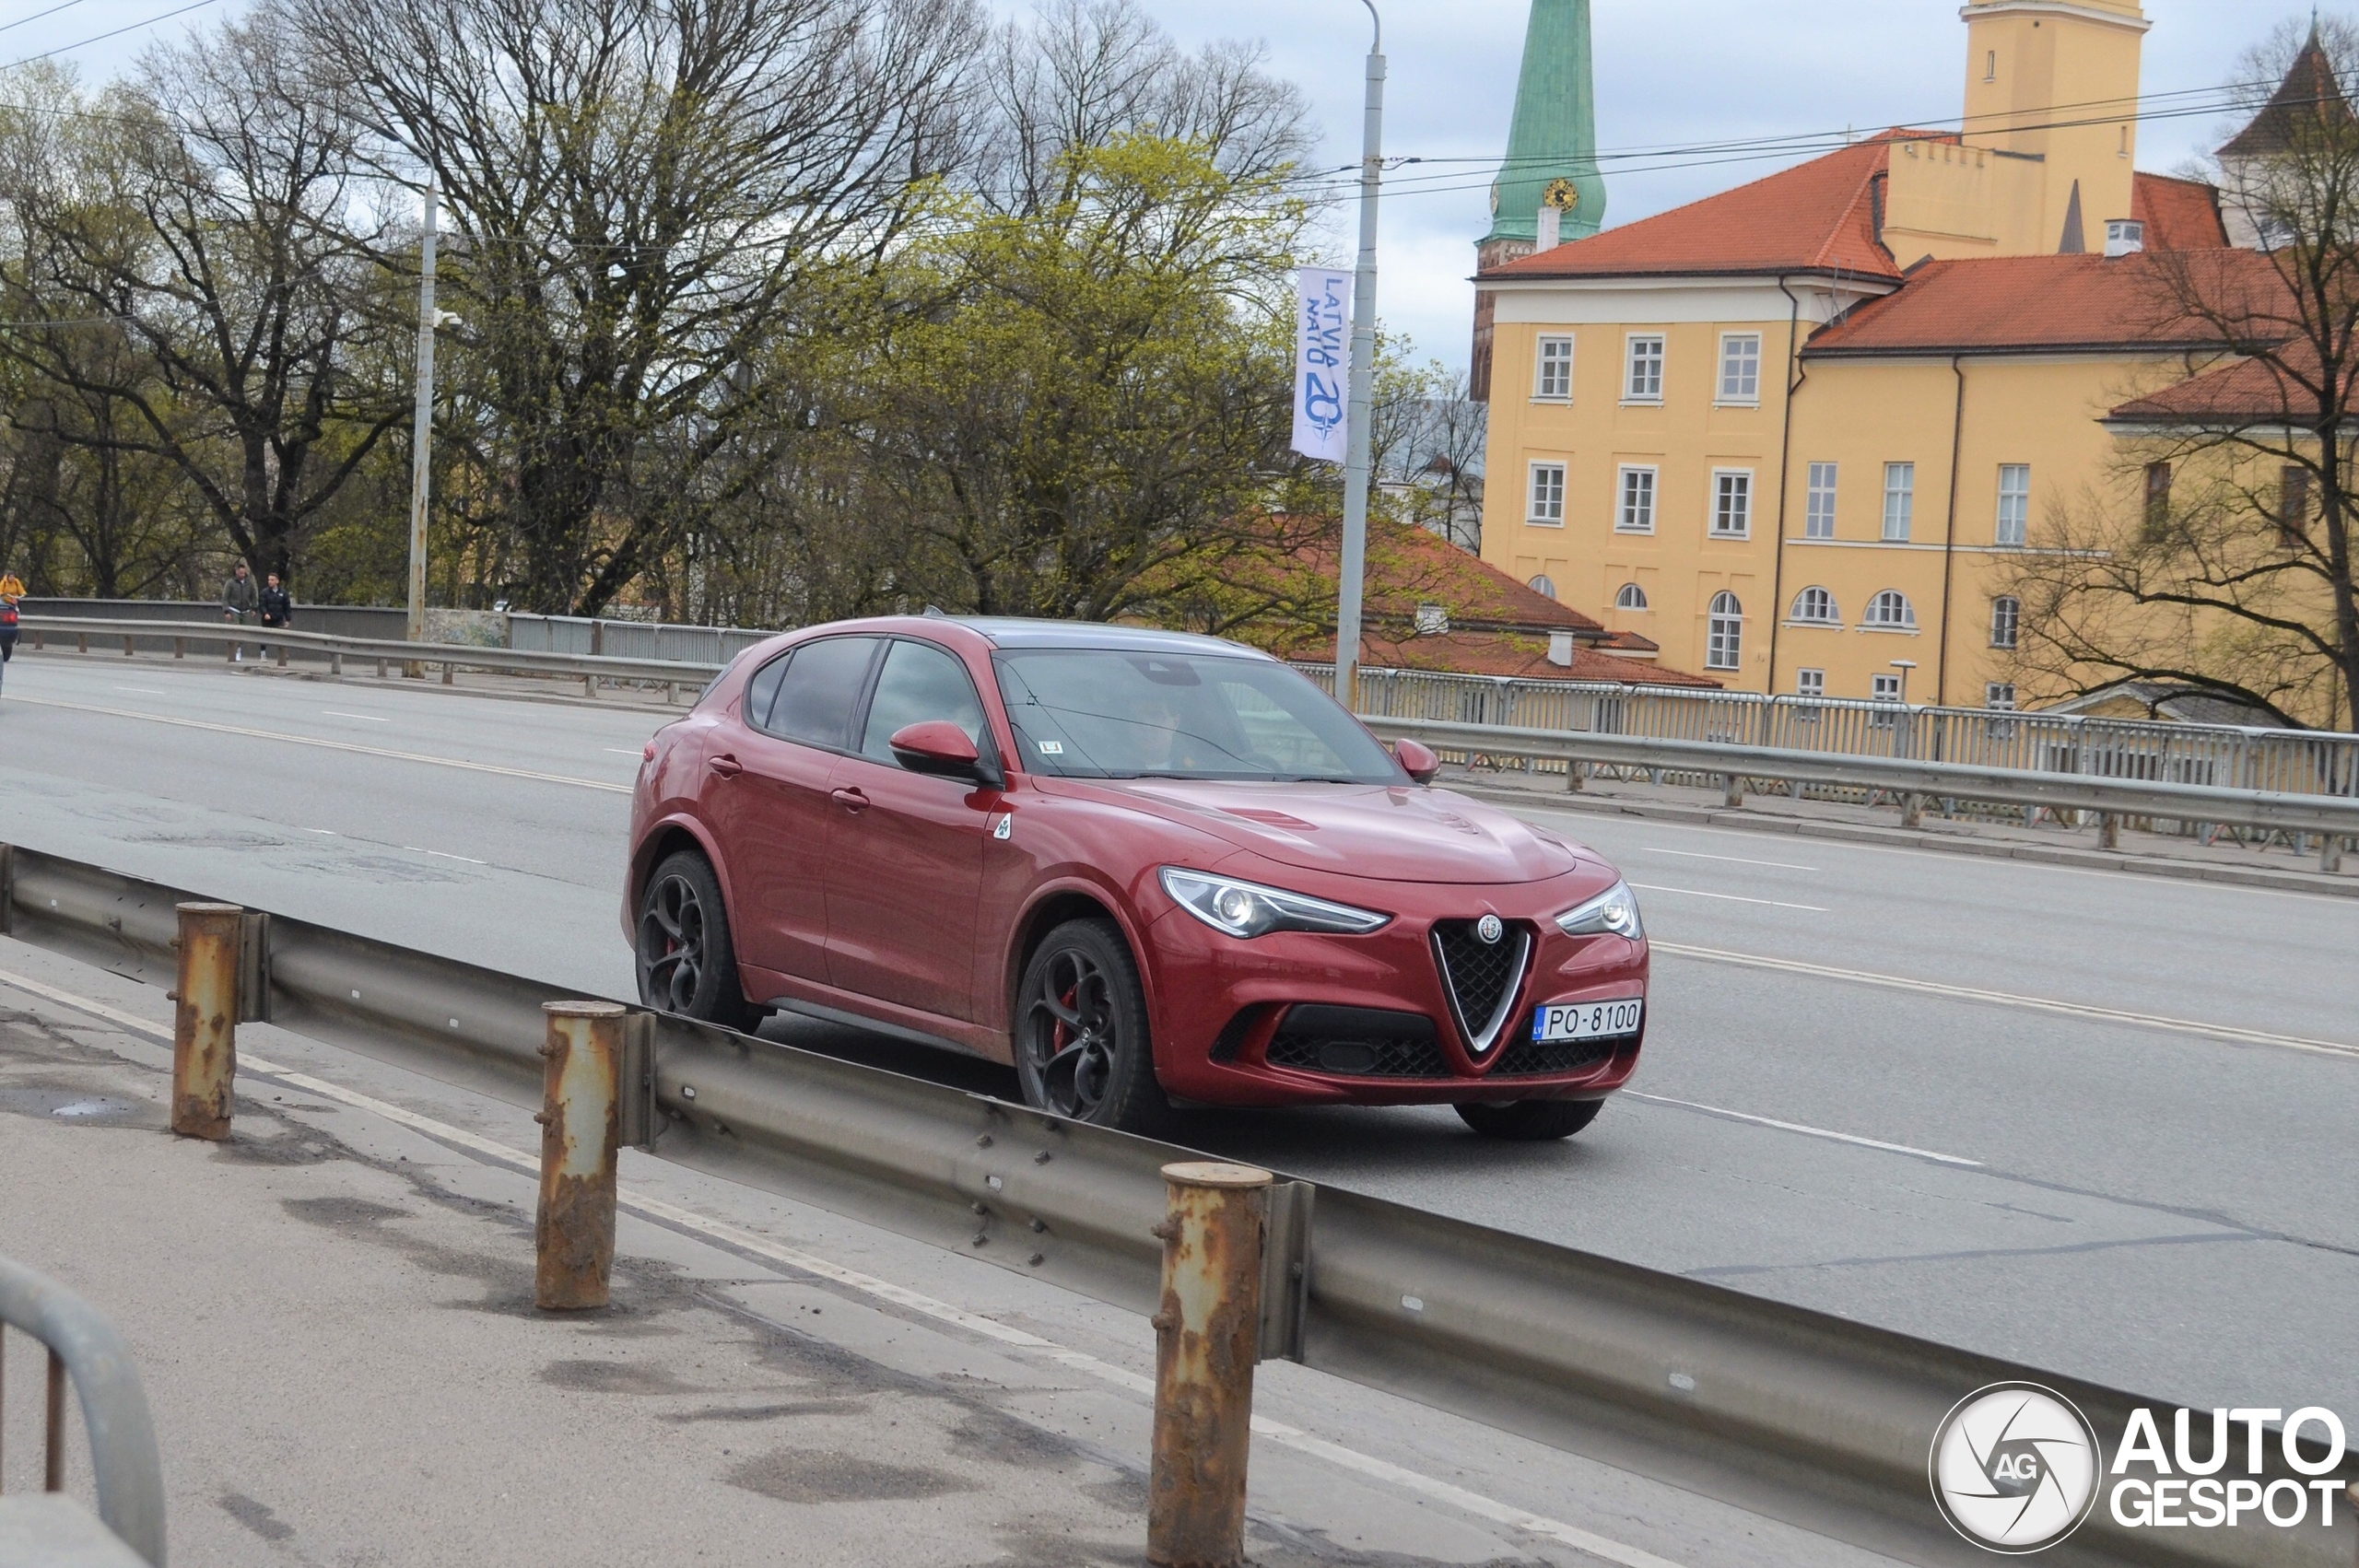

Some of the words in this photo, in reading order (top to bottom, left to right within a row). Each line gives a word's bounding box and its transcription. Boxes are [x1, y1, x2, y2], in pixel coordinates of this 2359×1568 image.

[1307, 298, 1325, 364] NATO
[1321, 278, 1343, 368] LATVIA
[1305, 372, 1343, 425] 20
[1533, 1026, 1543, 1035] LV
[1549, 1003, 1637, 1036] PO-8100
